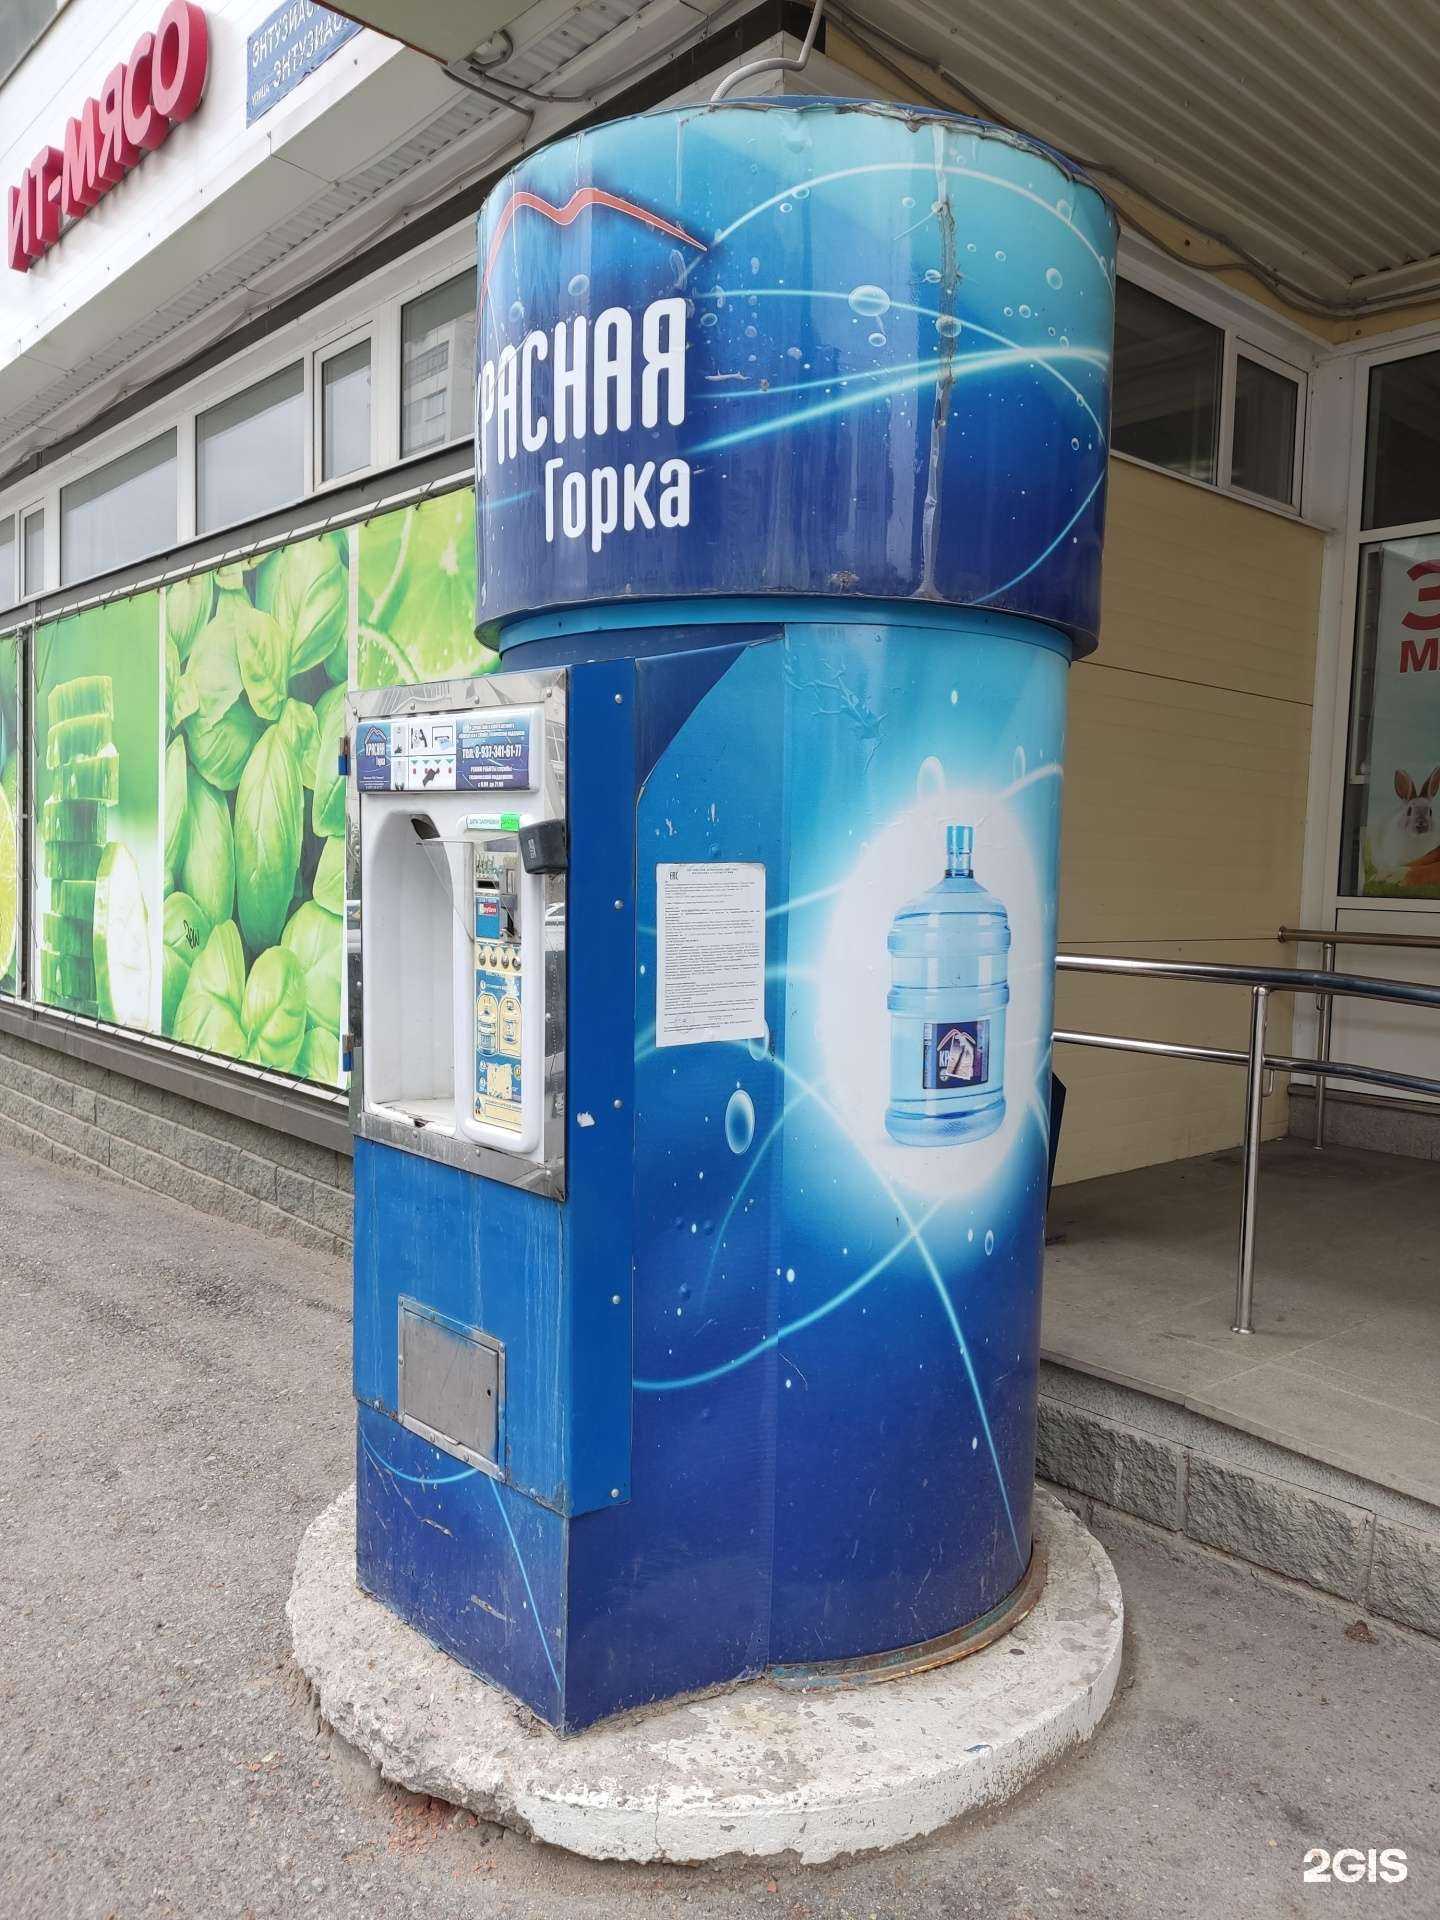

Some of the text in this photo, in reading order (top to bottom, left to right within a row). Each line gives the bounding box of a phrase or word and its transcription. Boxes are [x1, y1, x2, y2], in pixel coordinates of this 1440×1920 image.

[252, 0, 321, 68] ЭНТУЗИАС
[7, 0, 208, 273] ИТ-МЯСО
[544, 457, 690, 553] Горка
